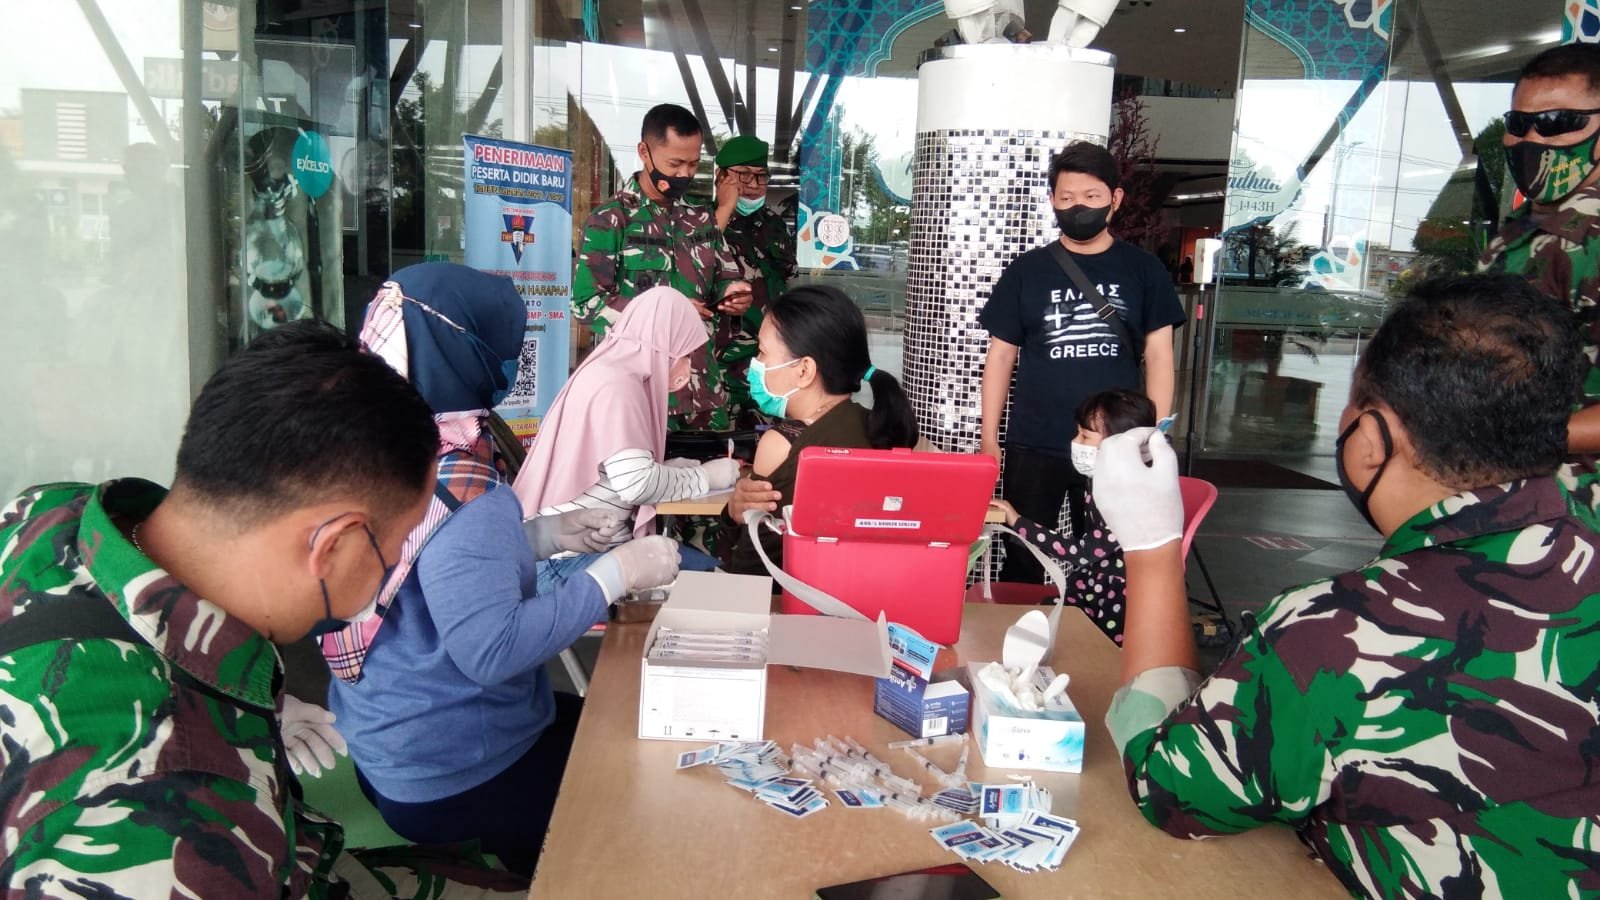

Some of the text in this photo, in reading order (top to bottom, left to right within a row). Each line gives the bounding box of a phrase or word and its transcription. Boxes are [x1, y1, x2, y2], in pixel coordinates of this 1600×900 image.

[297, 155, 329, 173] EXCELSO
[475, 144, 564, 173] PENERIMAAN
[472, 166, 565, 188] PESERTA DIDIK BARU
[528, 285, 568, 297] HARAPAN
[548, 311, 565, 320] SMA
[1050, 343, 1119, 359] GREECE
